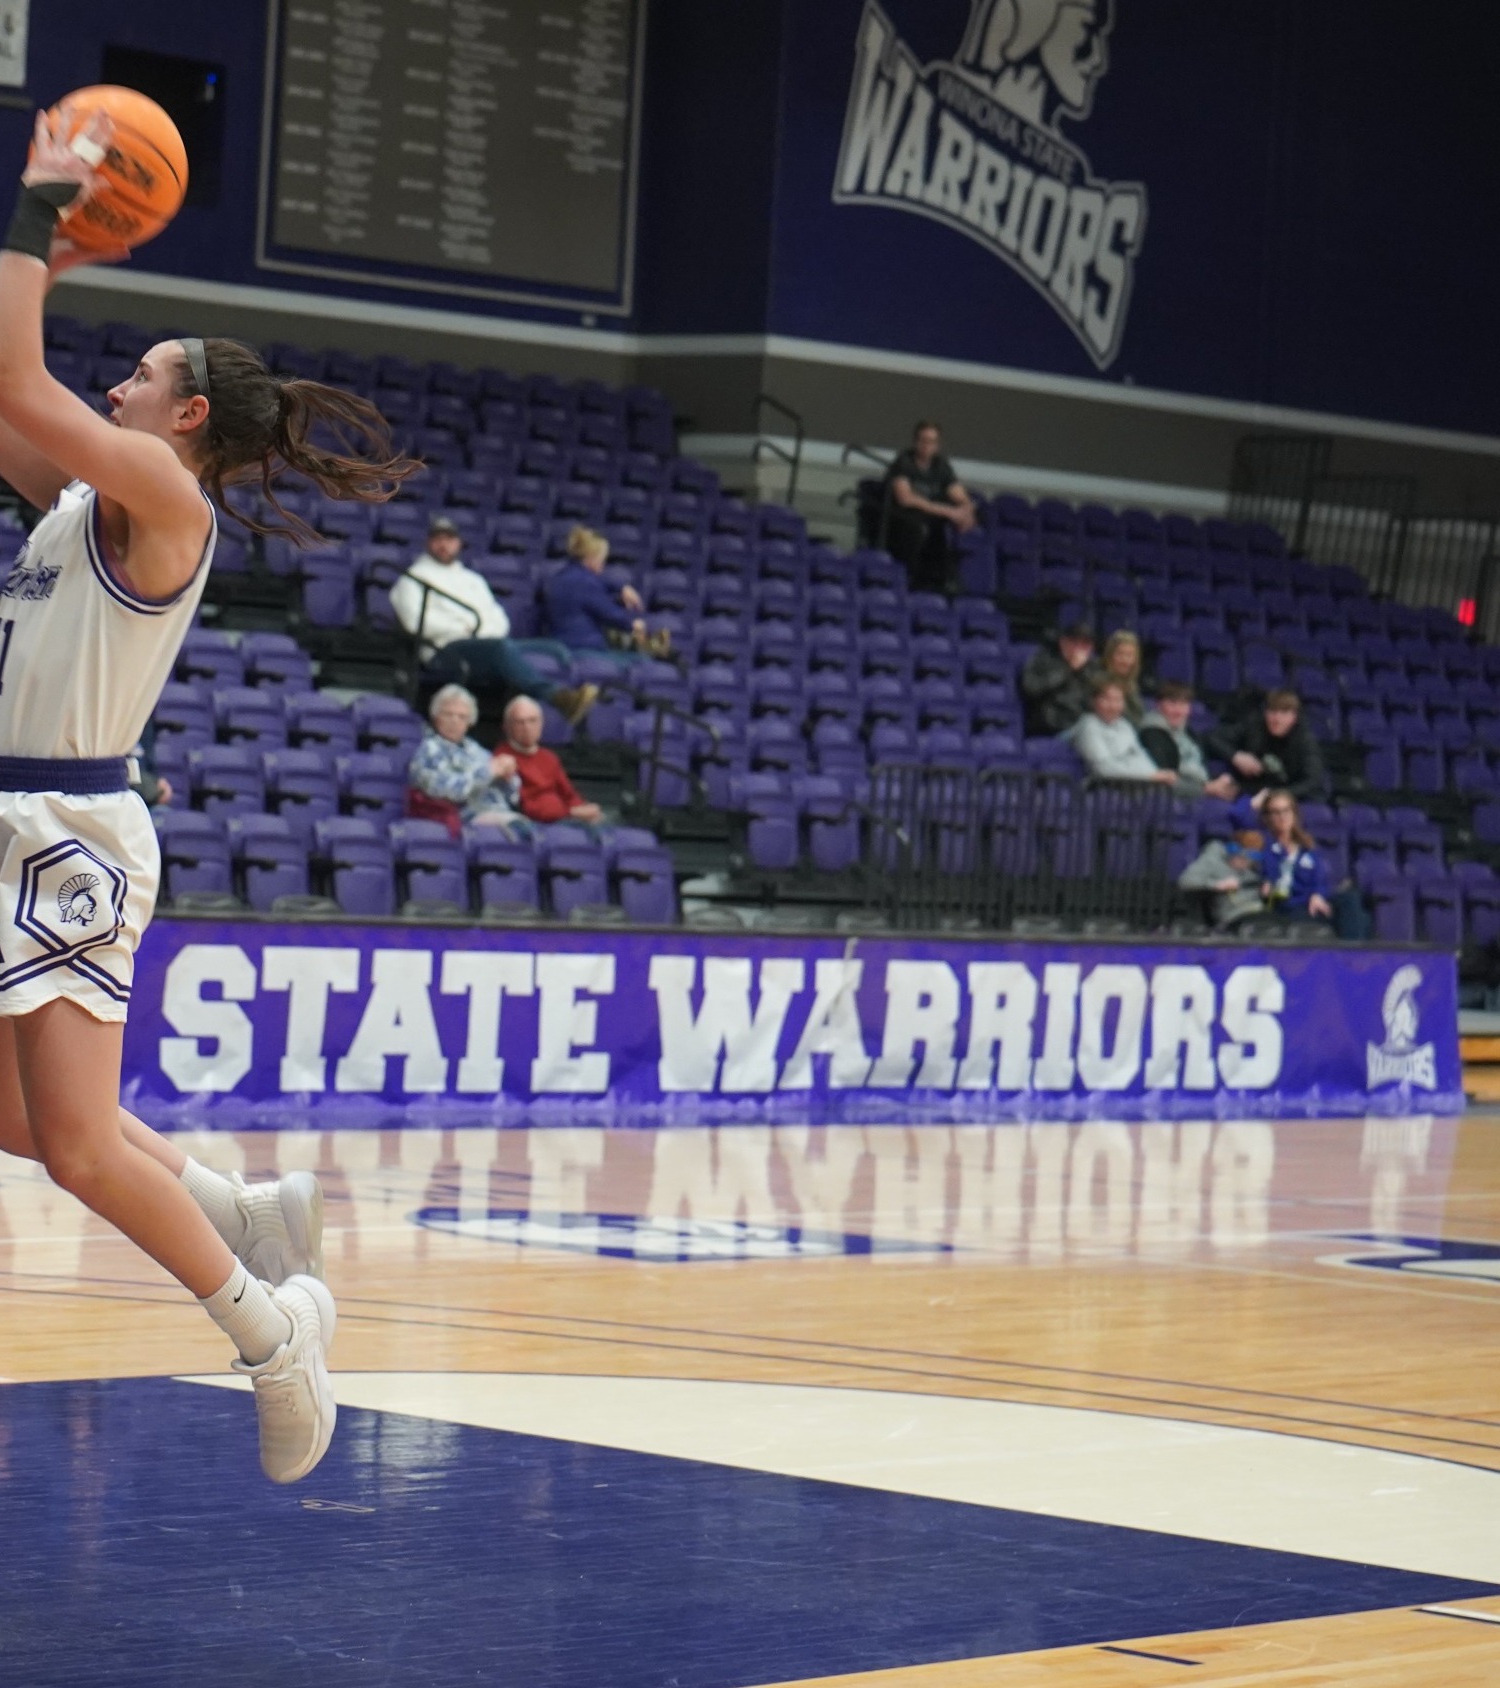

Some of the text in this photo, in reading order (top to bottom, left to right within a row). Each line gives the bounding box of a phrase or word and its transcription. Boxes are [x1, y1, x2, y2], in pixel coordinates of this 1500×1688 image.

[839, 12, 1142, 357] WARRIORS
[1020, 125, 1075, 186] STATE
[159, 944, 616, 1093] STATE
[648, 954, 1285, 1093] WARRIORS
